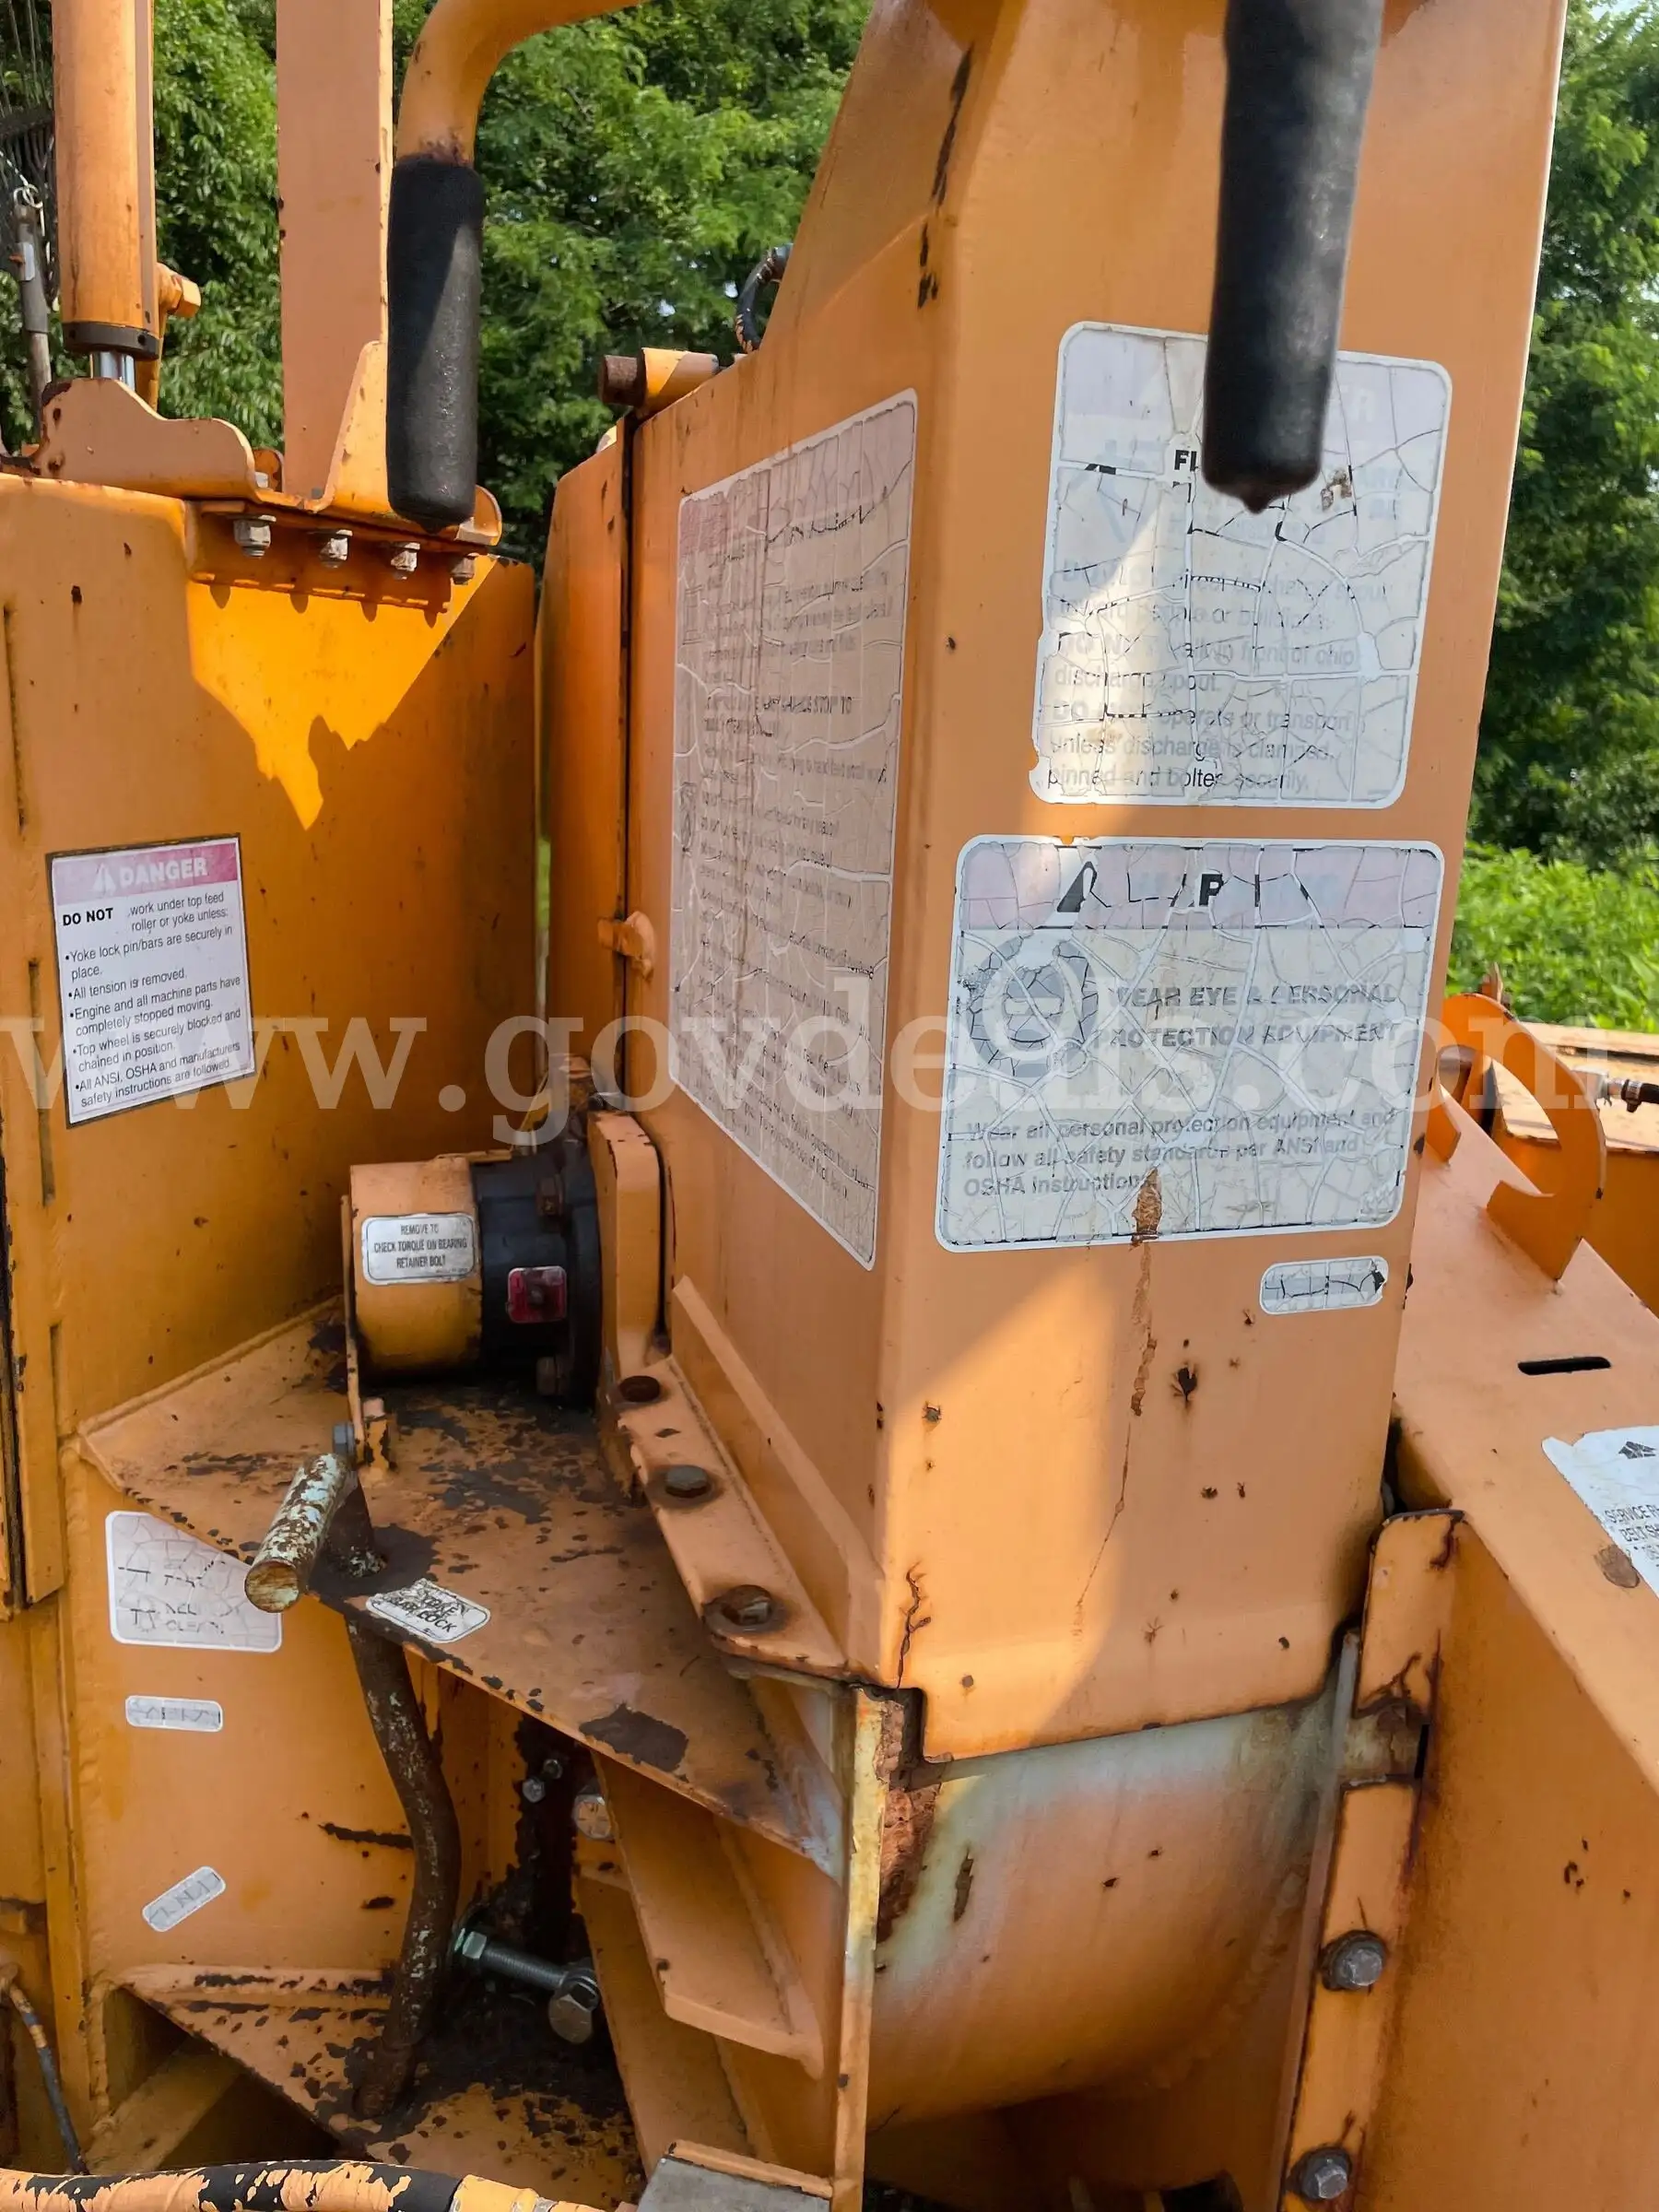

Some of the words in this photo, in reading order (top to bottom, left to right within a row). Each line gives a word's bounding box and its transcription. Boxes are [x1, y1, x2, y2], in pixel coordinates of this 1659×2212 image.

[119, 856, 208, 888] DANGER
[63, 912, 82, 927] DO
[86, 907, 114, 923] NOT
[130, 900, 155, 916] work
[157, 898, 184, 912] under
[187, 895, 203, 909] top
[204, 890, 225, 904] feed
[131, 917, 157, 933] roller
[159, 915, 170, 927] or
[171, 911, 195, 928] yoke
[197, 906, 229, 922] unless:
[69, 946, 97, 963] Yoke
[99, 941, 121, 958] lock
[123, 934, 164, 956] pin/bars
[166, 934, 182, 946] are
[184, 926, 223, 944] securely
[224, 924, 233, 936] in
[71, 965, 102, 982] place.
[73, 985, 87, 1000] All
[89, 980, 126, 997] tension
[141, 967, 188, 985] removed.
[74, 1003, 112, 1020] Engine
[113, 997, 134, 1011] and
[136, 994, 148, 1007] all
[150, 986, 193, 1005] machine
[194, 982, 218, 999] parts
[219, 974, 241, 990] have
[1188, 984, 1238, 1007] EYE
[76, 1016, 132, 1037] completely
[134, 1006, 174, 1025] stopped
[176, 996, 213, 1014] moving.
[76, 1042, 96, 1057] Top
[99, 1036, 130, 1052] wheel
[132, 1032, 141, 1044] is
[143, 1022, 185, 1041] securely
[186, 1014, 223, 1031] blocked
[224, 1007, 241, 1022] and
[78, 1054, 120, 1073] chained
[123, 1051, 132, 1063] in
[78, 1077, 92, 1092] All
[124, 1064, 158, 1081] OSHA
[159, 1058, 177, 1073] and
[179, 1043, 241, 1066] manufacturers
[80, 1088, 112, 1108] safety
[114, 1074, 172, 1099] instructions
[174, 1068, 191, 1082] are
[1059, 1114, 1143, 1145] personal
[373, 1241, 396, 1253] CHECK
[397, 1240, 426, 1253] TORQUE
[427, 1239, 438, 1251] ON
[438, 1237, 468, 1250] BEARING
[400, 1223, 429, 1236] REMOVE
[396, 1256, 429, 1269] RETAINER
[429, 1254, 447, 1267] BOLT
[1604, 1503, 1650, 1524] SERVICE
[417, 1609, 458, 1634] LOCK
